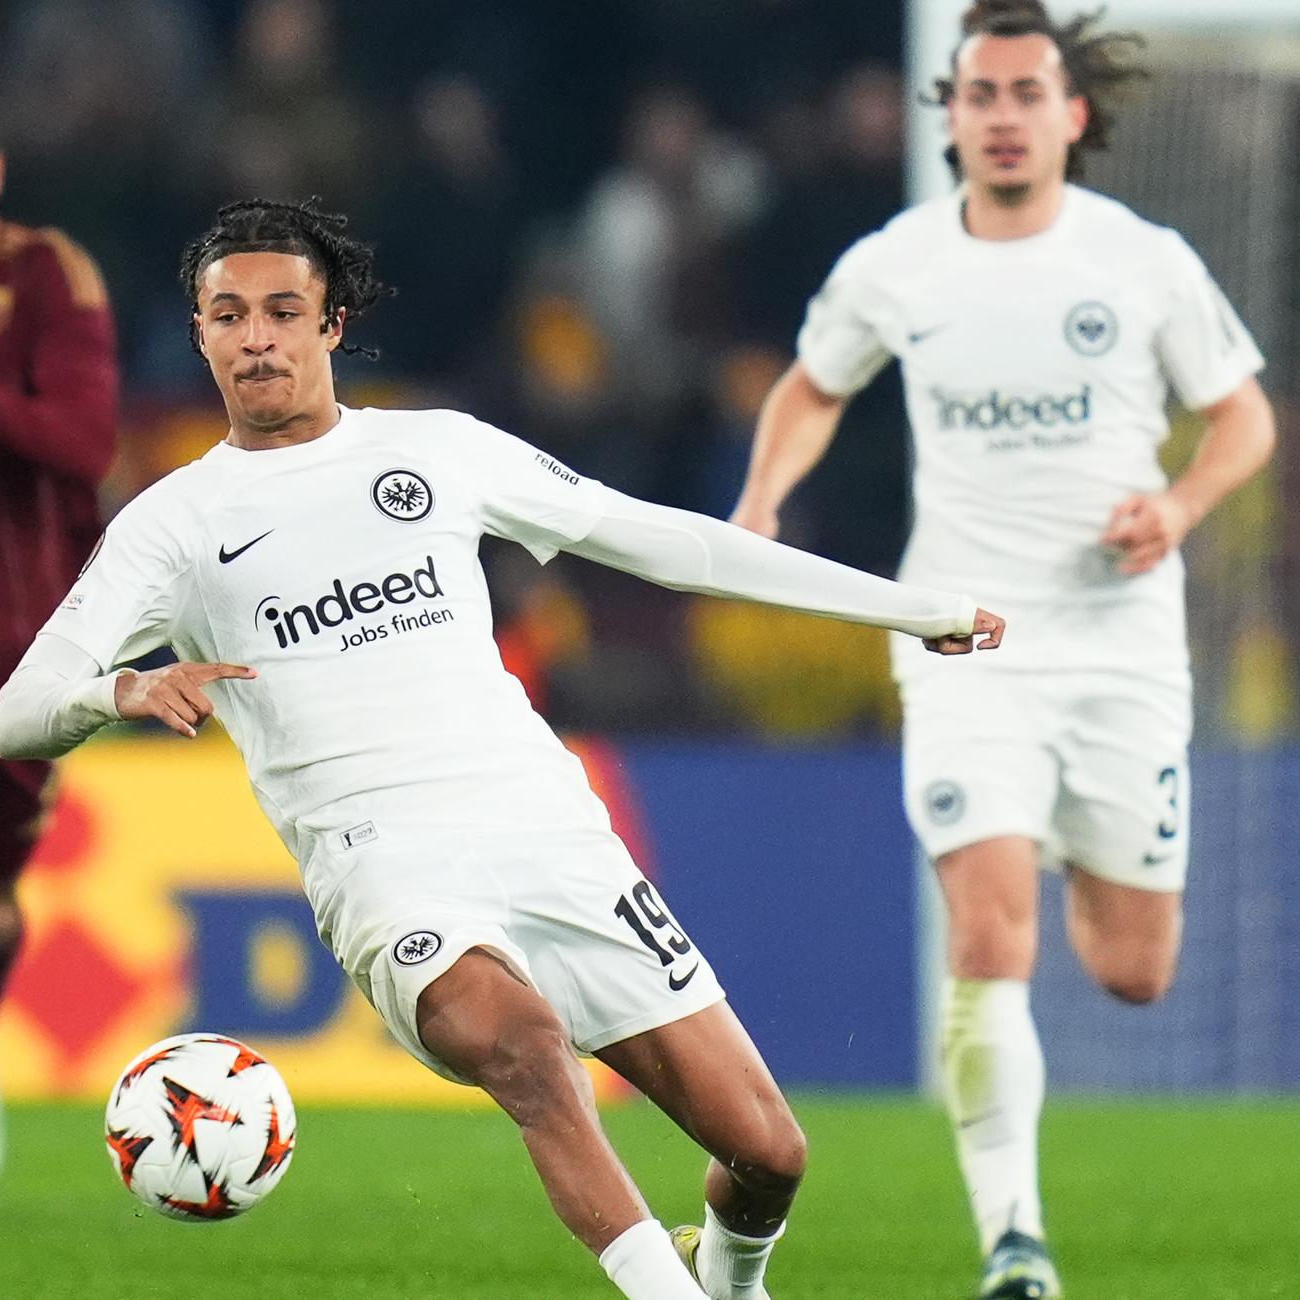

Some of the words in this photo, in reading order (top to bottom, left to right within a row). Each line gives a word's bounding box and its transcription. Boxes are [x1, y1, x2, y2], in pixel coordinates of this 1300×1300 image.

[534, 452, 580, 486] reload
[255, 555, 444, 649] indeed
[340, 624, 389, 652] Jobs
[390, 608, 455, 635] finden
[1157, 766, 1178, 840] 3
[613, 880, 691, 967] 19
